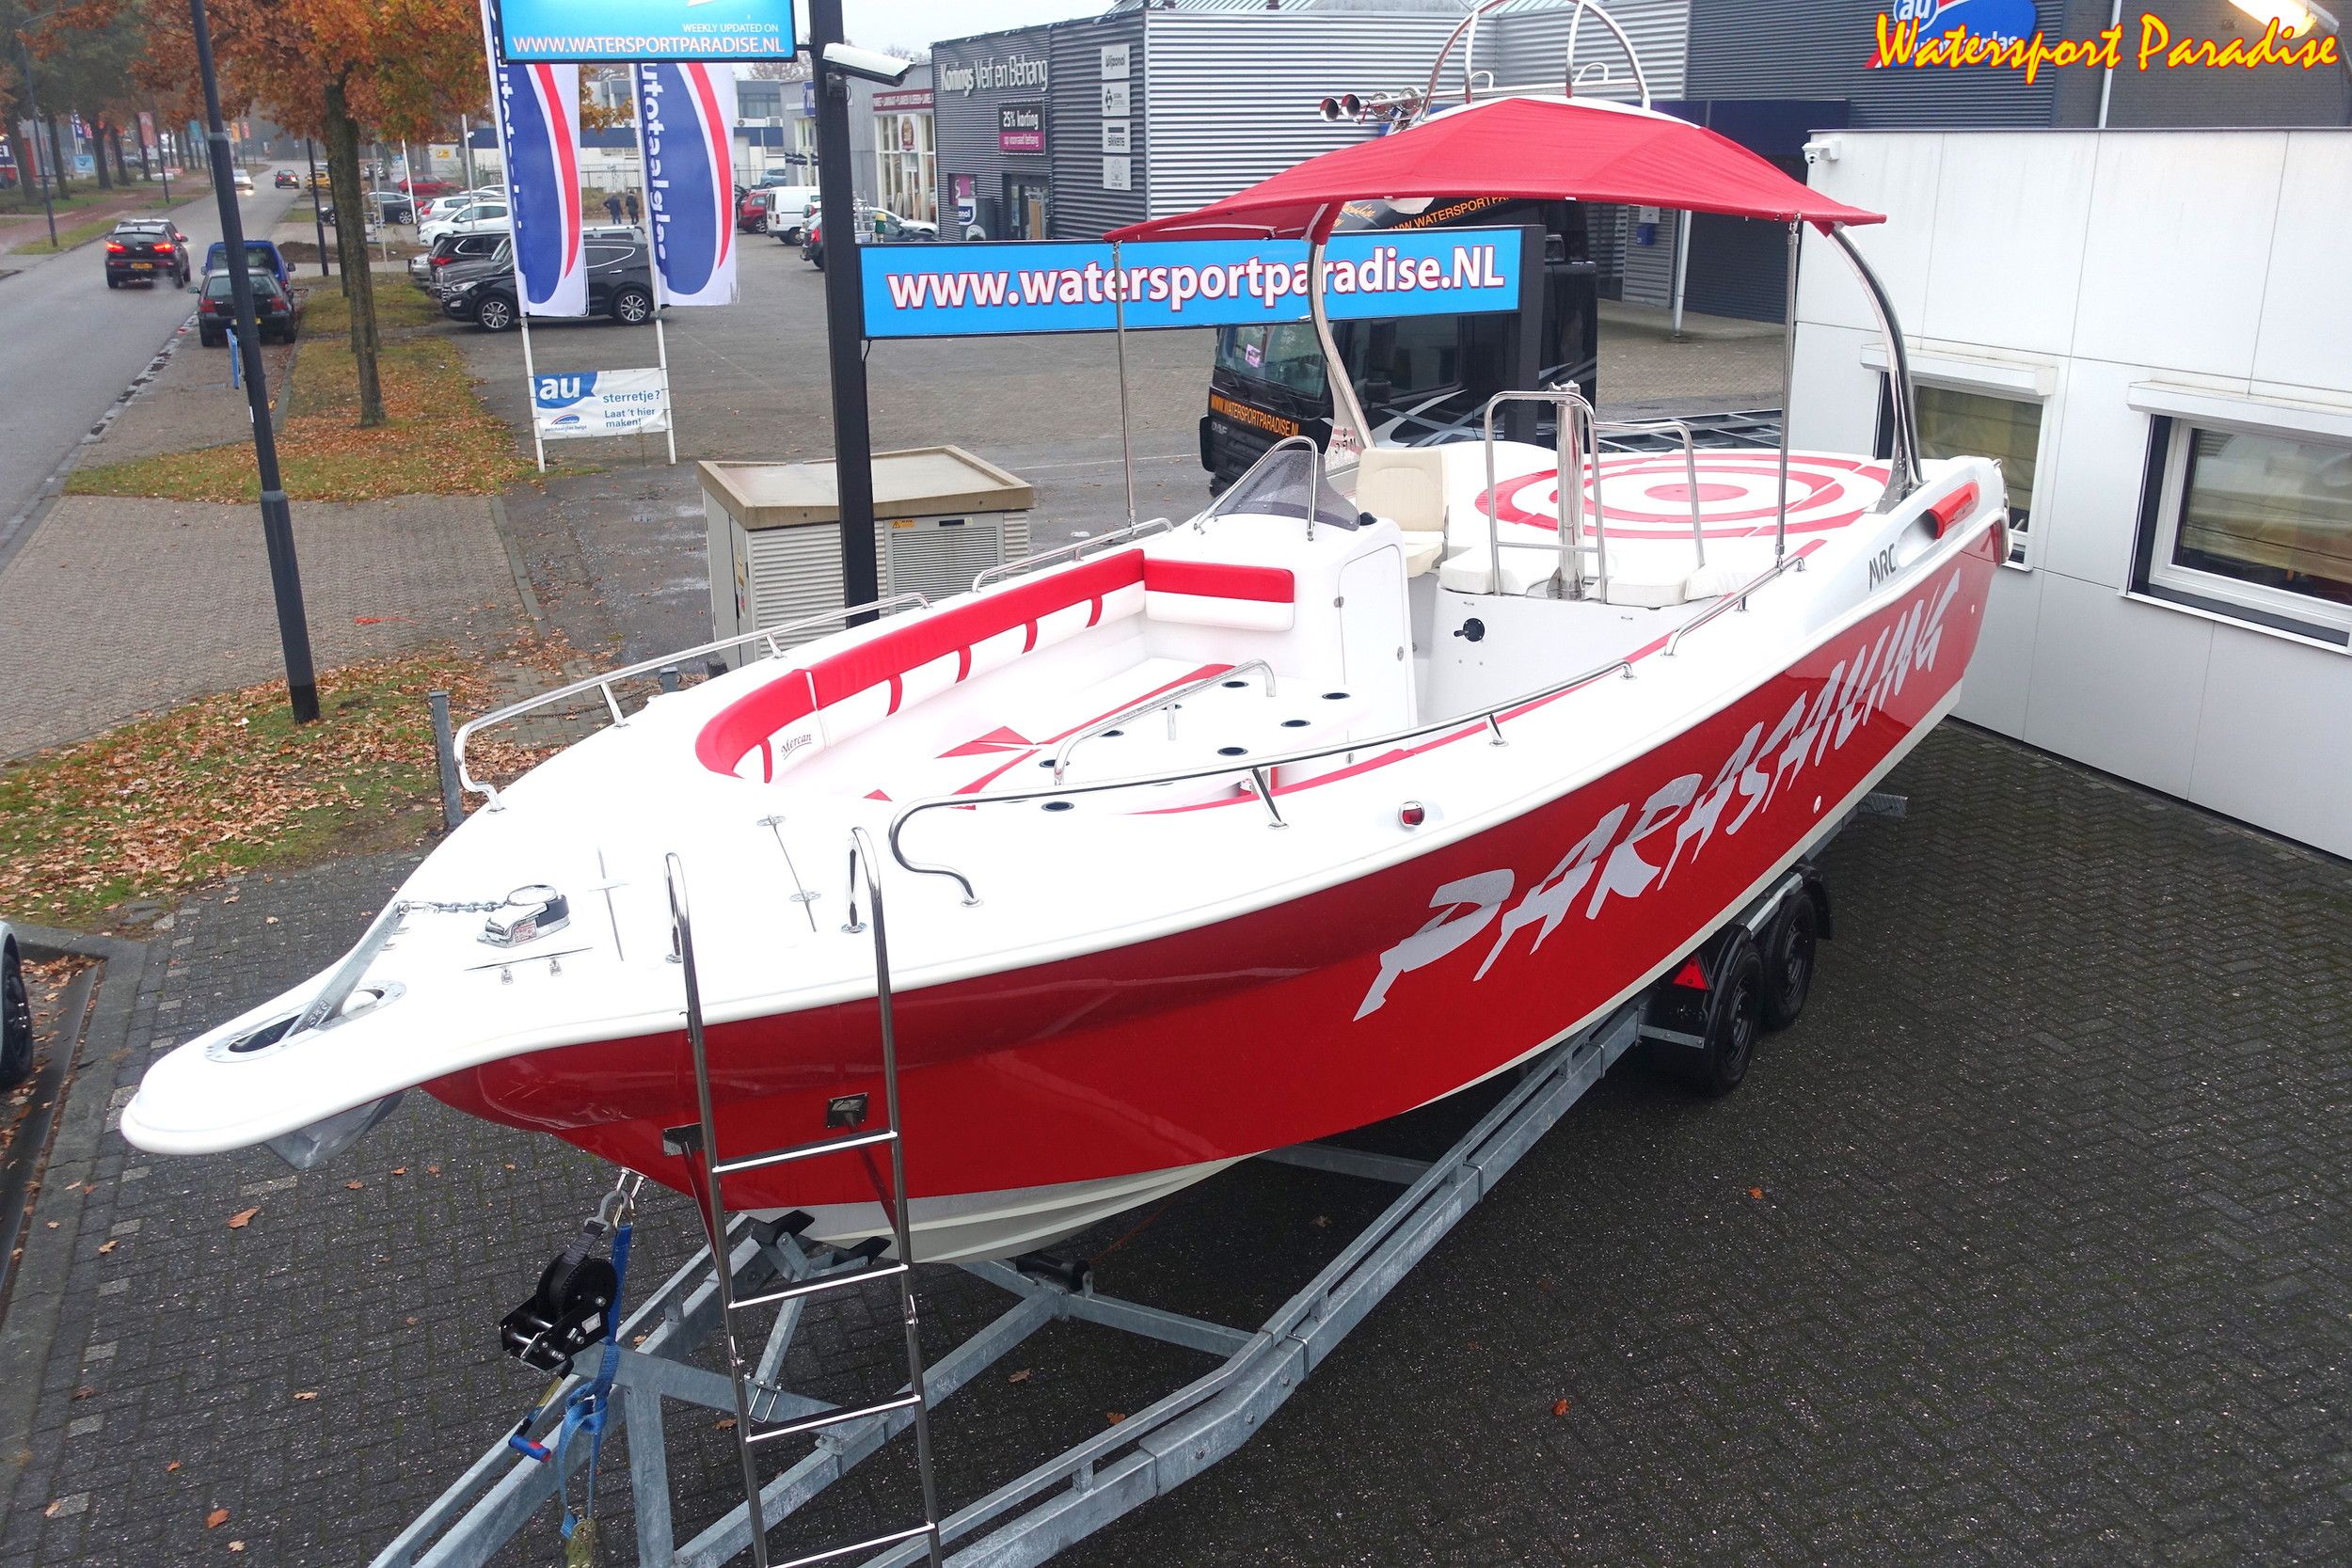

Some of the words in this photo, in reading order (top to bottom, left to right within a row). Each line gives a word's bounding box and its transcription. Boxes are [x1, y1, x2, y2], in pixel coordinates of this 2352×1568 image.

[682, 24, 718, 34] WEEKLY
[720, 24, 762, 33] UPDATED
[764, 24, 779, 33] ON
[513, 37, 785, 54] WWW.WATERSPORTPARADISE.NL
[941, 62, 975, 97] Konings
[975, 57, 994, 89] Verf
[995, 65, 1009, 87] en
[1009, 54, 1048, 92] Behang
[1003, 111, 1016, 127] 25%
[1017, 110, 1039, 130] korting
[887, 245, 1505, 312] www.watersportparadise.NL
[539, 376, 581, 401] au
[603, 389, 660, 404] sterretje?
[605, 409, 626, 419] Laat
[637, 407, 656, 417] hier
[606, 418, 642, 429] maken!
[1868, 543, 1897, 593] MRC
[781, 733, 812, 755] Mercan
[1353, 567, 1961, 1022] PARASAILING
